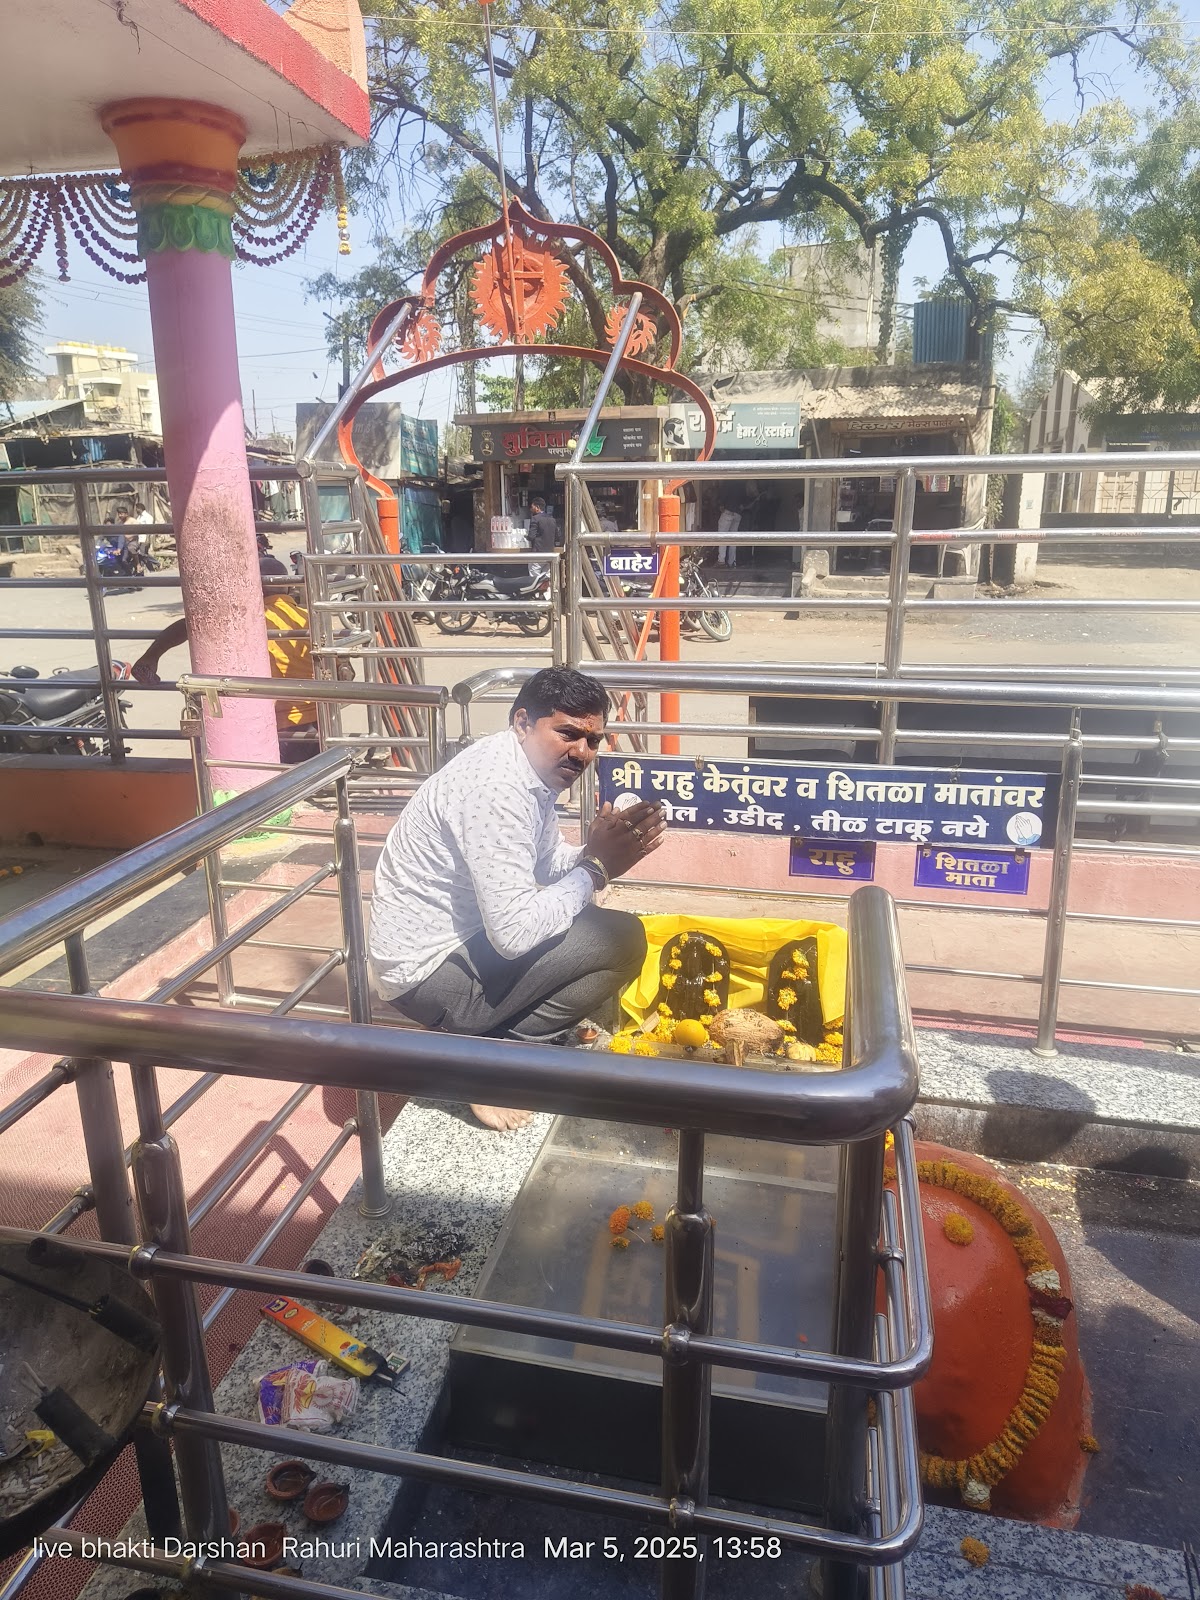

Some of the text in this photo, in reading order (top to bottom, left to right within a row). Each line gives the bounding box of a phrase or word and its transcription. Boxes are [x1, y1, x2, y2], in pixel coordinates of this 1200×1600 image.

[609, 551, 653, 572] बाहेर
[612, 761, 1045, 808] श्री राहु केतूंवर व शितळा मातांवर
[723, 804, 785, 828] उडीद
[810, 810, 869, 834] तीळ
[875, 817, 934, 842] टाकू
[941, 815, 990, 838] नये
[808, 848, 857, 875] राहु
[935, 852, 1010, 875] शितळा
[945, 871, 998, 888] माता
